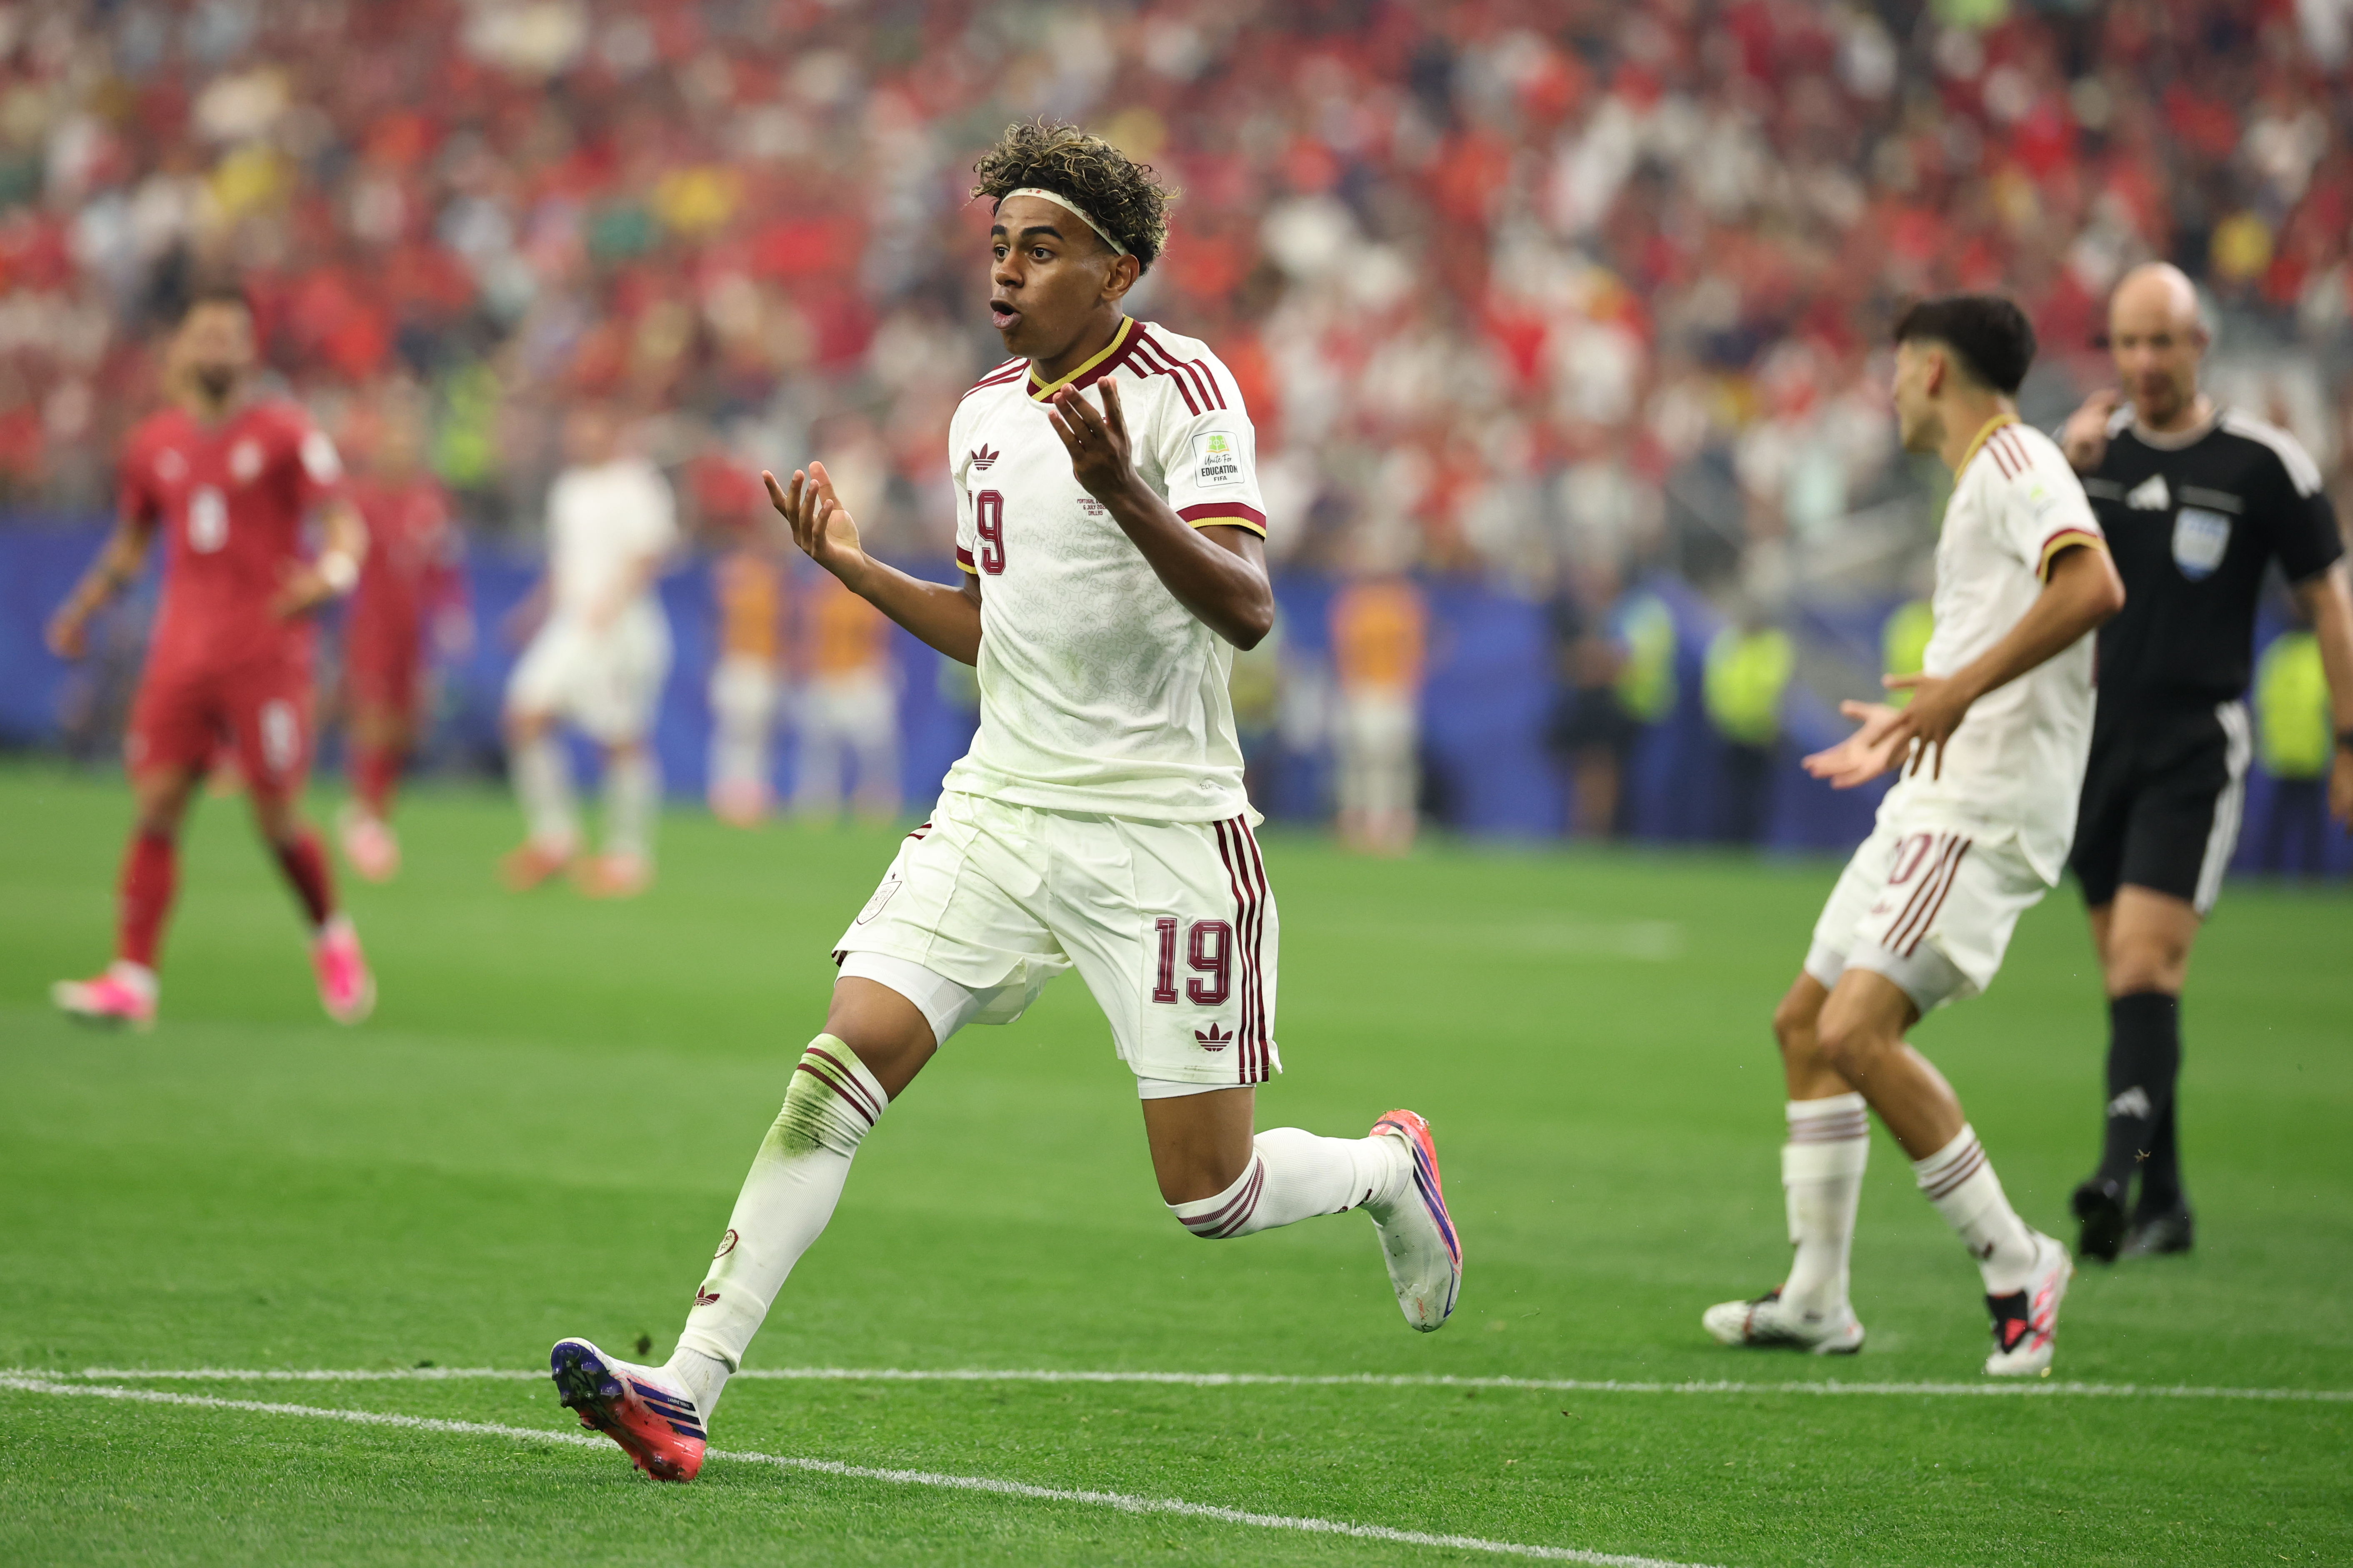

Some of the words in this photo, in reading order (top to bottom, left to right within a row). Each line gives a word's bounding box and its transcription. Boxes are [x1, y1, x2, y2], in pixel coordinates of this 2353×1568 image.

[1201, 464, 1238, 477] EDUCATION
[1204, 454, 1222, 466] Unite
[1222, 454, 1232, 463] For
[967, 490, 1006, 575] 9
[1153, 917, 1233, 1006] 19
